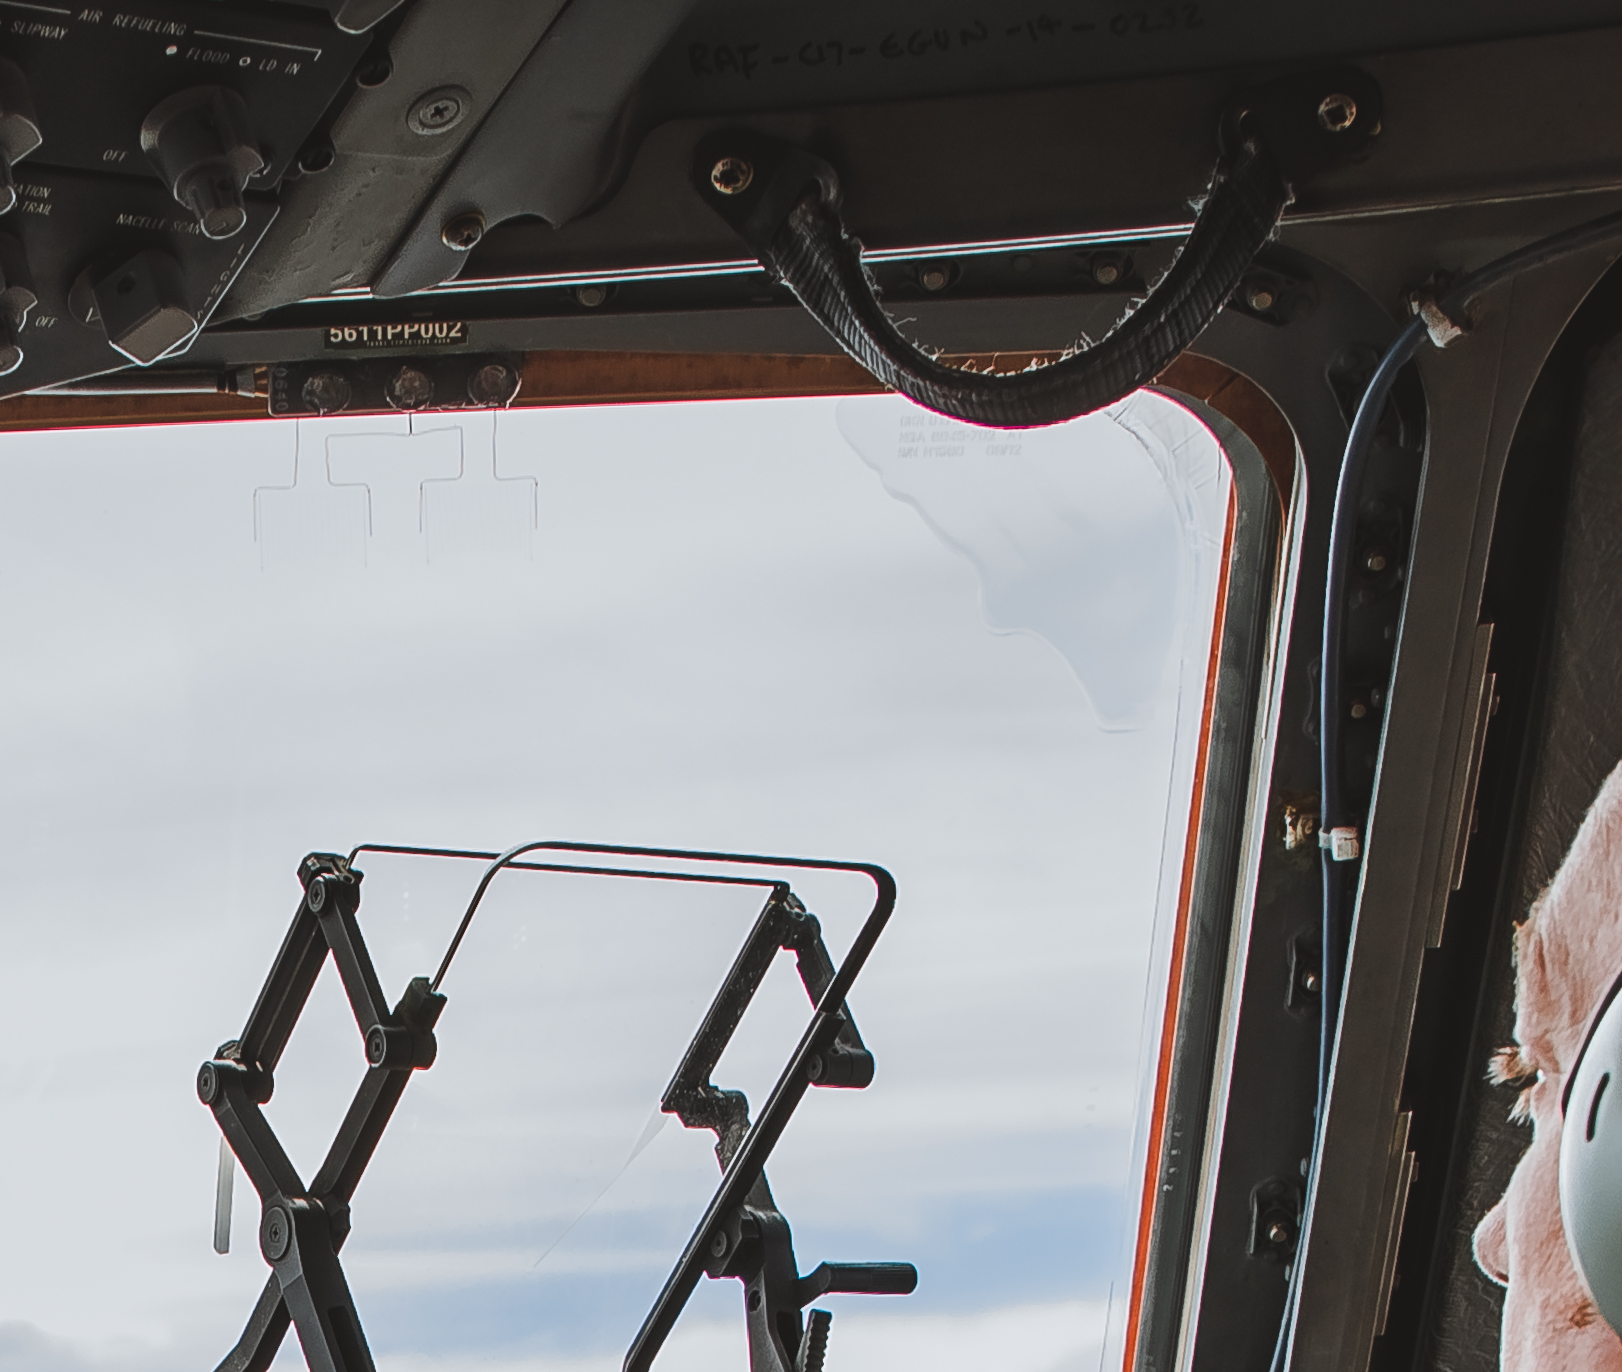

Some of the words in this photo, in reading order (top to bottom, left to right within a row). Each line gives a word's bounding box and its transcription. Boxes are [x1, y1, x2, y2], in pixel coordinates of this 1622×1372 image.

[12, 20, 69, 41] SLIPWAY
[78, 8, 103, 23] AIR
[111, 14, 187, 36] REFUELING
[187, 46, 230, 65] FLOOD
[103, 150, 128, 162] OFF
